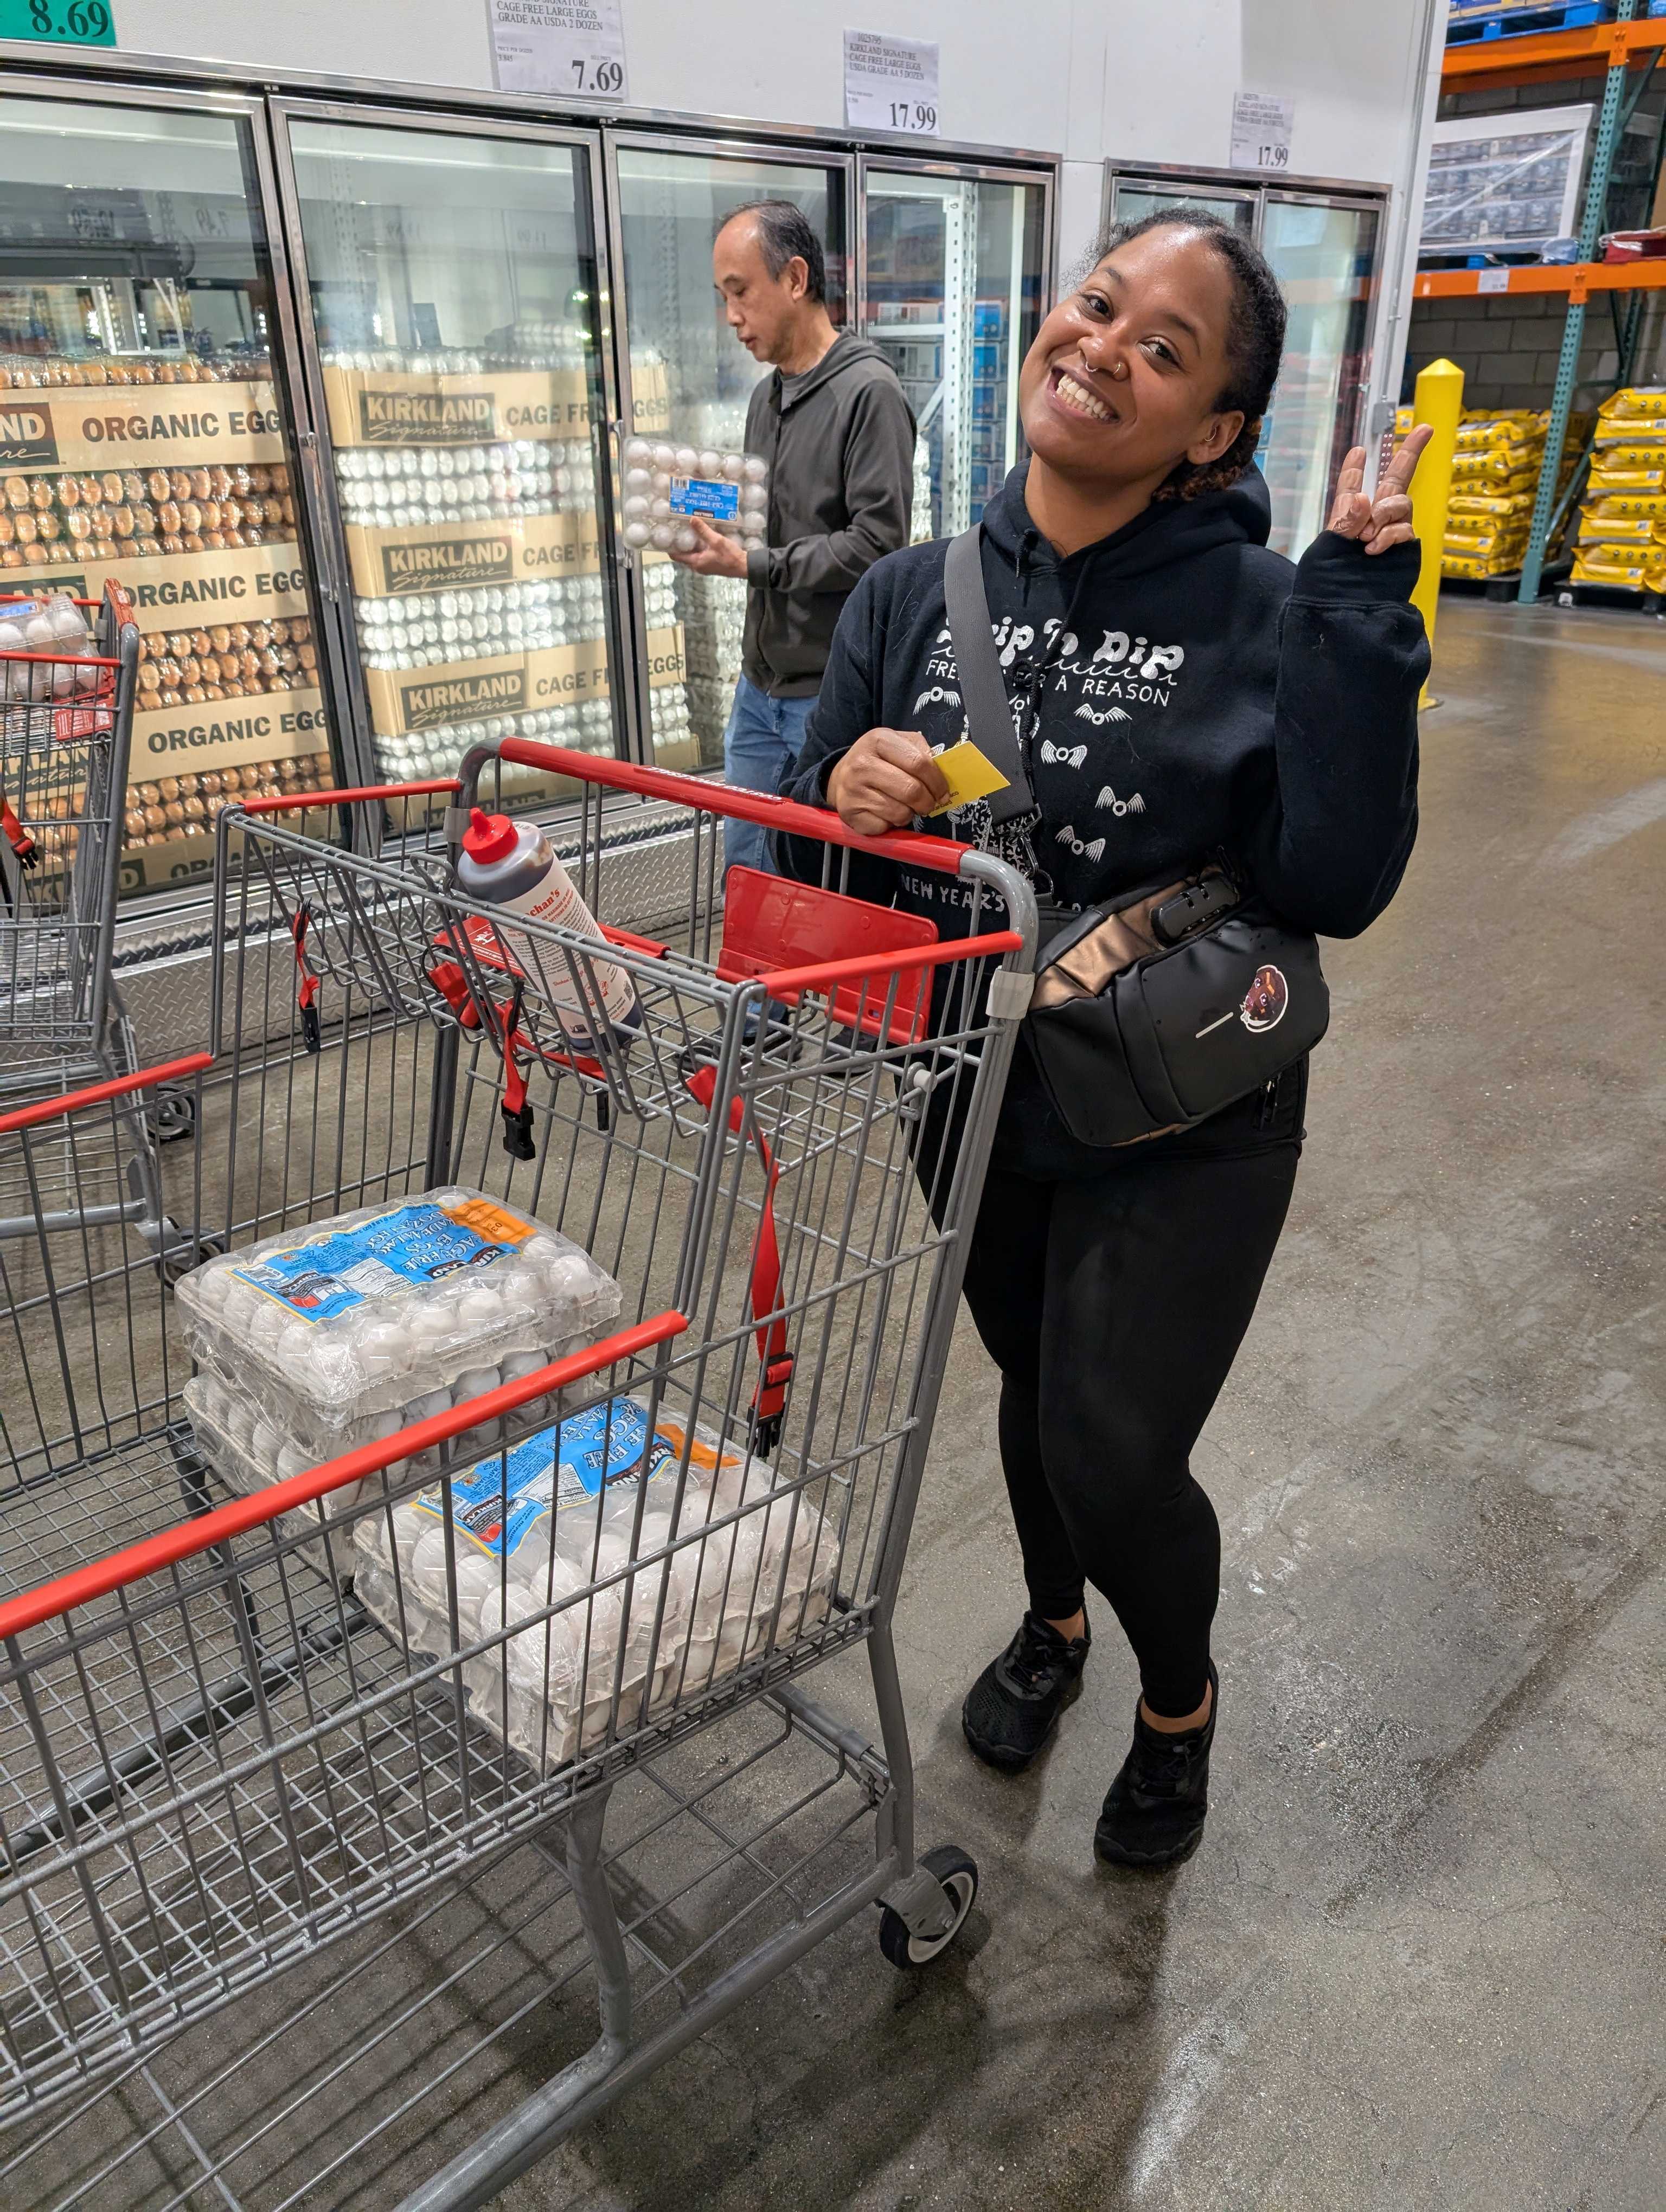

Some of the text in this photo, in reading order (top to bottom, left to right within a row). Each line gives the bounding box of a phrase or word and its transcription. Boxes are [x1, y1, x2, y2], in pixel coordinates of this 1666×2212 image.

[29, 0, 108, 37] 8.69
[497, 1, 597, 20] CAGE FREE LARGE EGGS
[498, 12, 603, 31] GRADE AA USDA 2 DOZEN
[850, 43, 917, 61] KIRKLAND SIGNATURE
[850, 53, 921, 71] CAGE FREE LARGE EGGS
[572, 60, 623, 92] 7.69
[850, 62, 867, 73] USDA
[868, 65, 889, 75] GRADE
[904, 70, 925, 80] DOZEN
[889, 102, 937, 131] 17.99
[1258, 146, 1288, 166] 17.99
[368, 397, 490, 421] KIRKLAND
[506, 404, 560, 426] CAGE
[82, 413, 219, 442] ORGANIC
[230, 410, 280, 434] EGG
[389, 542, 507, 573] KIRKLAND
[523, 543, 574, 566] CAGE
[257, 569, 305, 594] EGG
[392, 568, 508, 591] Signature
[1093, 629, 1184, 679] Dip
[408, 675, 521, 711] KIRKLAND
[536, 672, 586, 696] CAGE
[1055, 674, 1067, 691] A
[1082, 678, 1170, 707] REASON
[411, 699, 522, 728] Signature
[148, 710, 326, 753] ORGANIC EGG
[723, 785, 783, 800] COSTCO
[529, 889, 560, 917] chan's
[901, 873, 1006, 912] NEW YEAR'S
[403, 1230, 422, 1242] AA
[421, 1217, 456, 1237] RADE
[587, 1408, 605, 1423] AA
[472, 1464, 501, 1490] OMPLIANT
